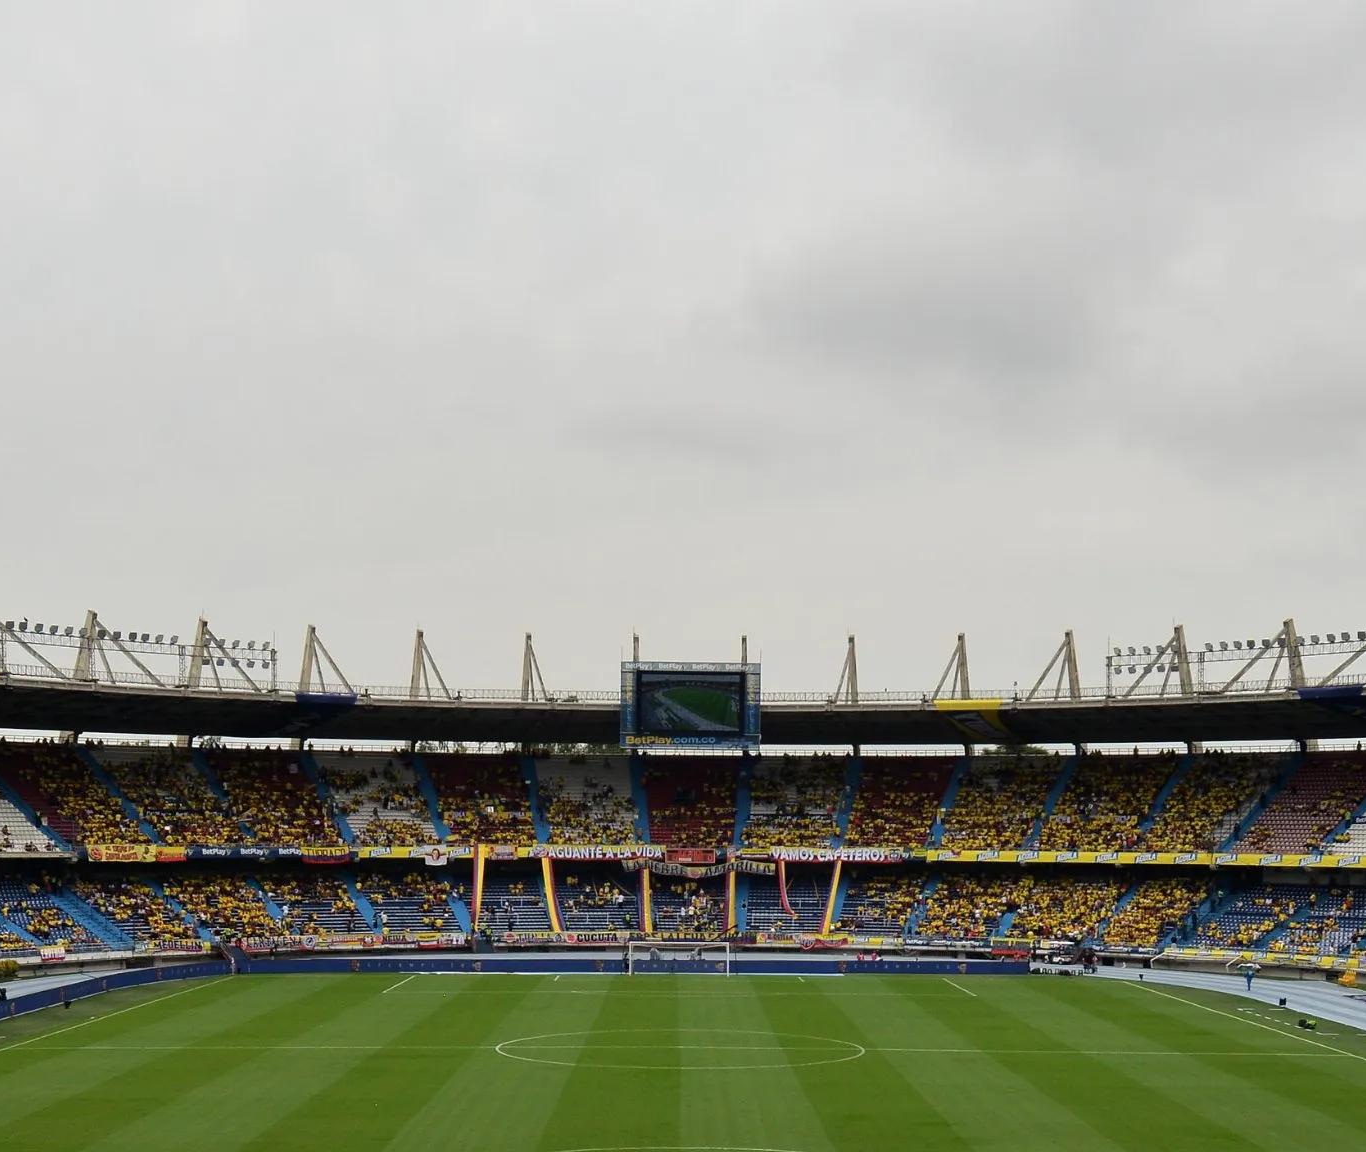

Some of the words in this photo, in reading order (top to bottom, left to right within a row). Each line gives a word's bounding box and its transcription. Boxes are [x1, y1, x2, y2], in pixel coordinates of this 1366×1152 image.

[625, 662, 648, 670] BetPlay
[659, 662, 682, 670] BetPlay
[692, 662, 715, 670] BetPlay
[625, 736, 715, 744] BetPlay.com.co
[202, 848, 226, 856] BetPlay
[240, 848, 264, 856] BetPlay
[279, 848, 302, 856] BetPlay
[605, 847, 615, 858] A
[617, 847, 631, 858] LA
[771, 848, 814, 860] VAMOS
[817, 849, 885, 860] CAFETEROS
[577, 933, 617, 942] CUCUTA
[153, 940, 202, 950] MEDELLIN
